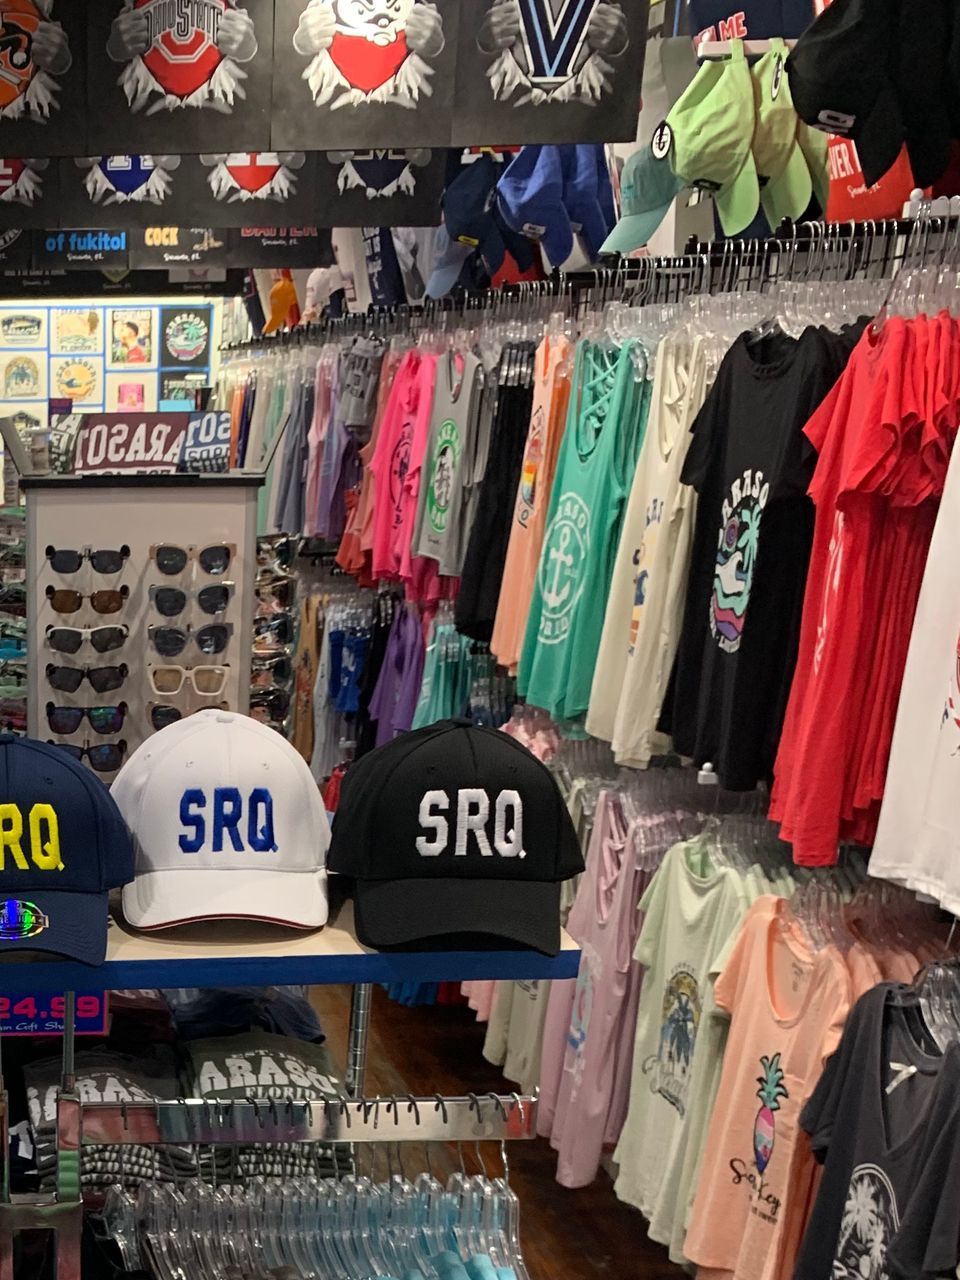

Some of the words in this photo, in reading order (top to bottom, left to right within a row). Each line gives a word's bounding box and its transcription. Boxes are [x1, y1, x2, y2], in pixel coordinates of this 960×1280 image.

[45, 233, 65, 252] of
[69, 231, 126, 251] fukitol
[178, 787, 279, 854] SRQ
[415, 788, 527, 860] SRQ
